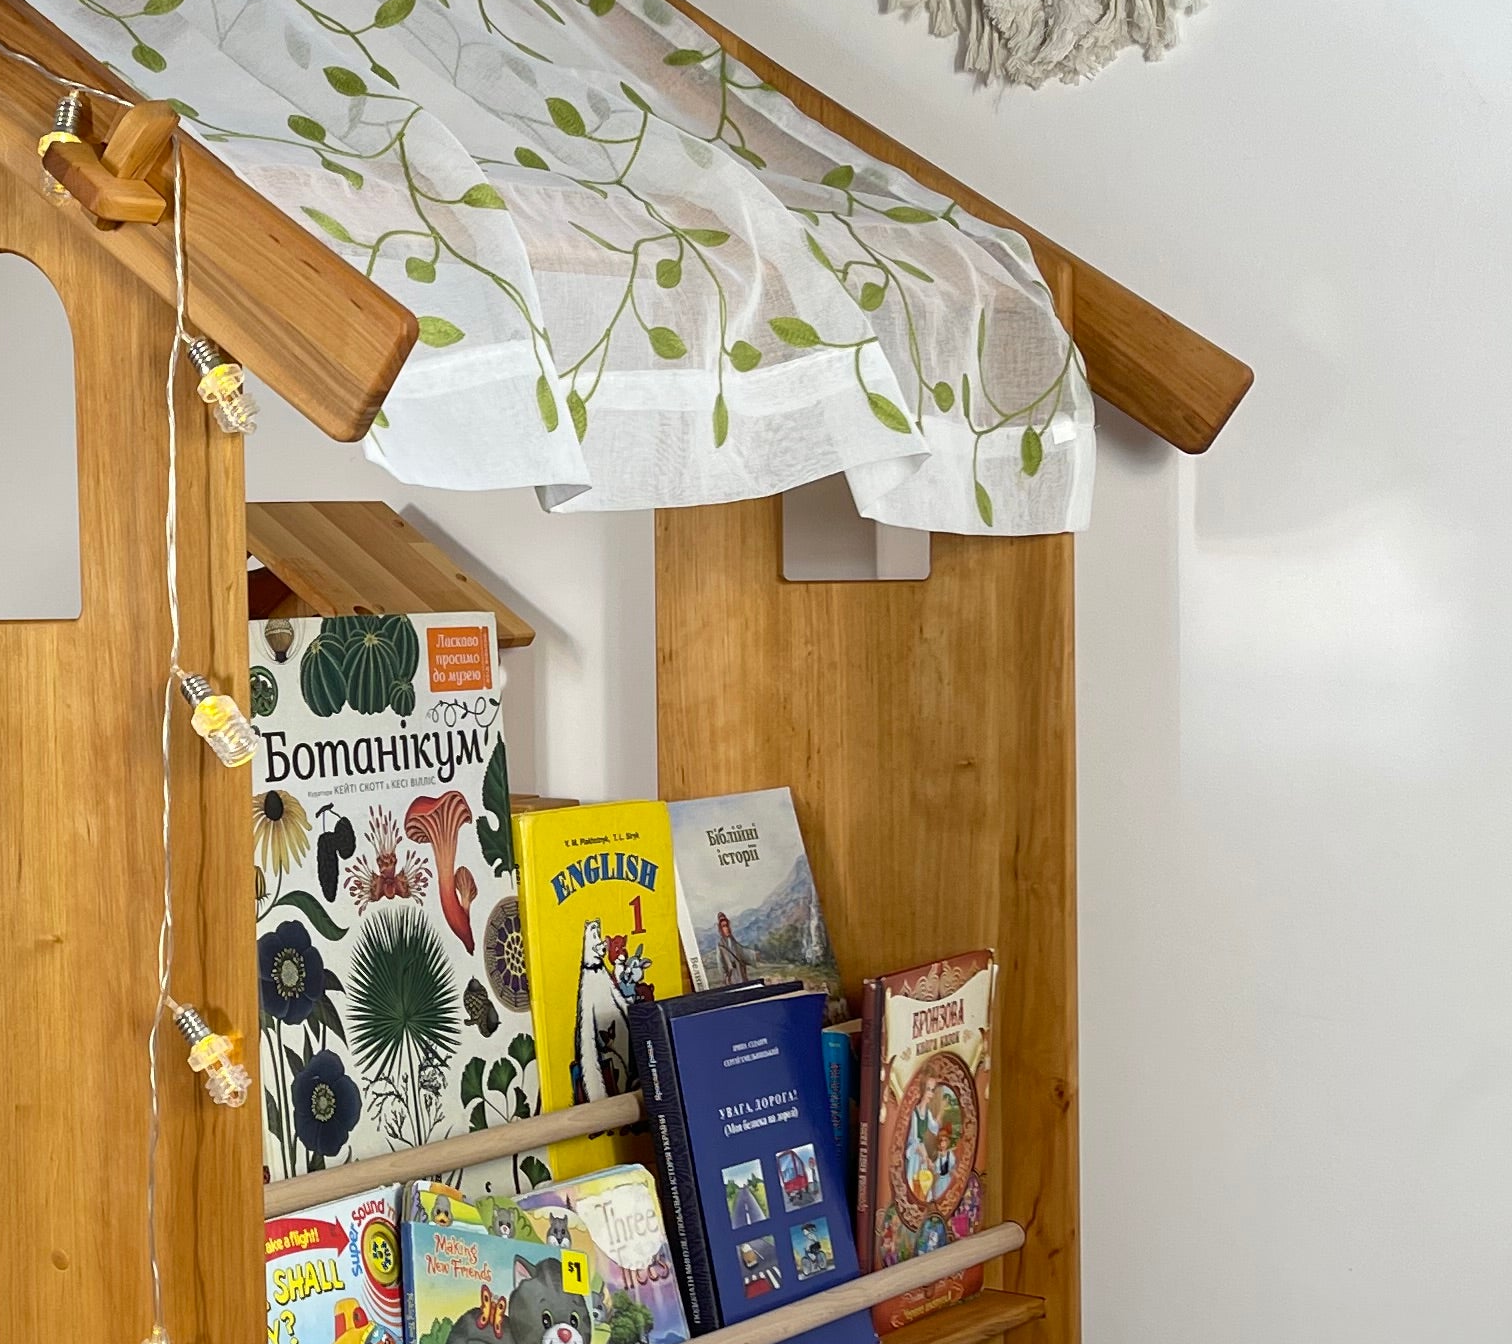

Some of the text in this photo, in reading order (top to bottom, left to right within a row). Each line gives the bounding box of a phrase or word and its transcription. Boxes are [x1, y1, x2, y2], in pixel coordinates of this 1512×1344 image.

[435, 633, 479, 649] Ласкаво
[435, 653, 481, 670] просимо
[432, 667, 482, 686] до музею
[261, 719, 484, 783] Ботанікум
[333, 782, 357, 796] КЕЙТІ
[359, 780, 385, 793] СКОТТ
[391, 779, 409, 789] КЕСІ
[705, 822, 760, 846] Біблійні
[716, 843, 760, 867] історії
[550, 852, 659, 906] ENGLISH
[628, 895, 647, 935] 1
[755, 1088, 799, 1112] ДОРОГА!
[657, 1114, 671, 1151] УКРАЇНИ
[665, 1151, 678, 1185] ІСТОРІЯ
[351, 1197, 385, 1227] sound
[594, 1200, 659, 1246] Three
[264, 1227, 320, 1255] ake a flight!
[349, 1222, 363, 1277] super
[434, 1233, 478, 1264] Making
[273, 1257, 346, 1306] SHALL
[426, 1254, 492, 1282] New Friends
[568, 1261, 582, 1282] $1
